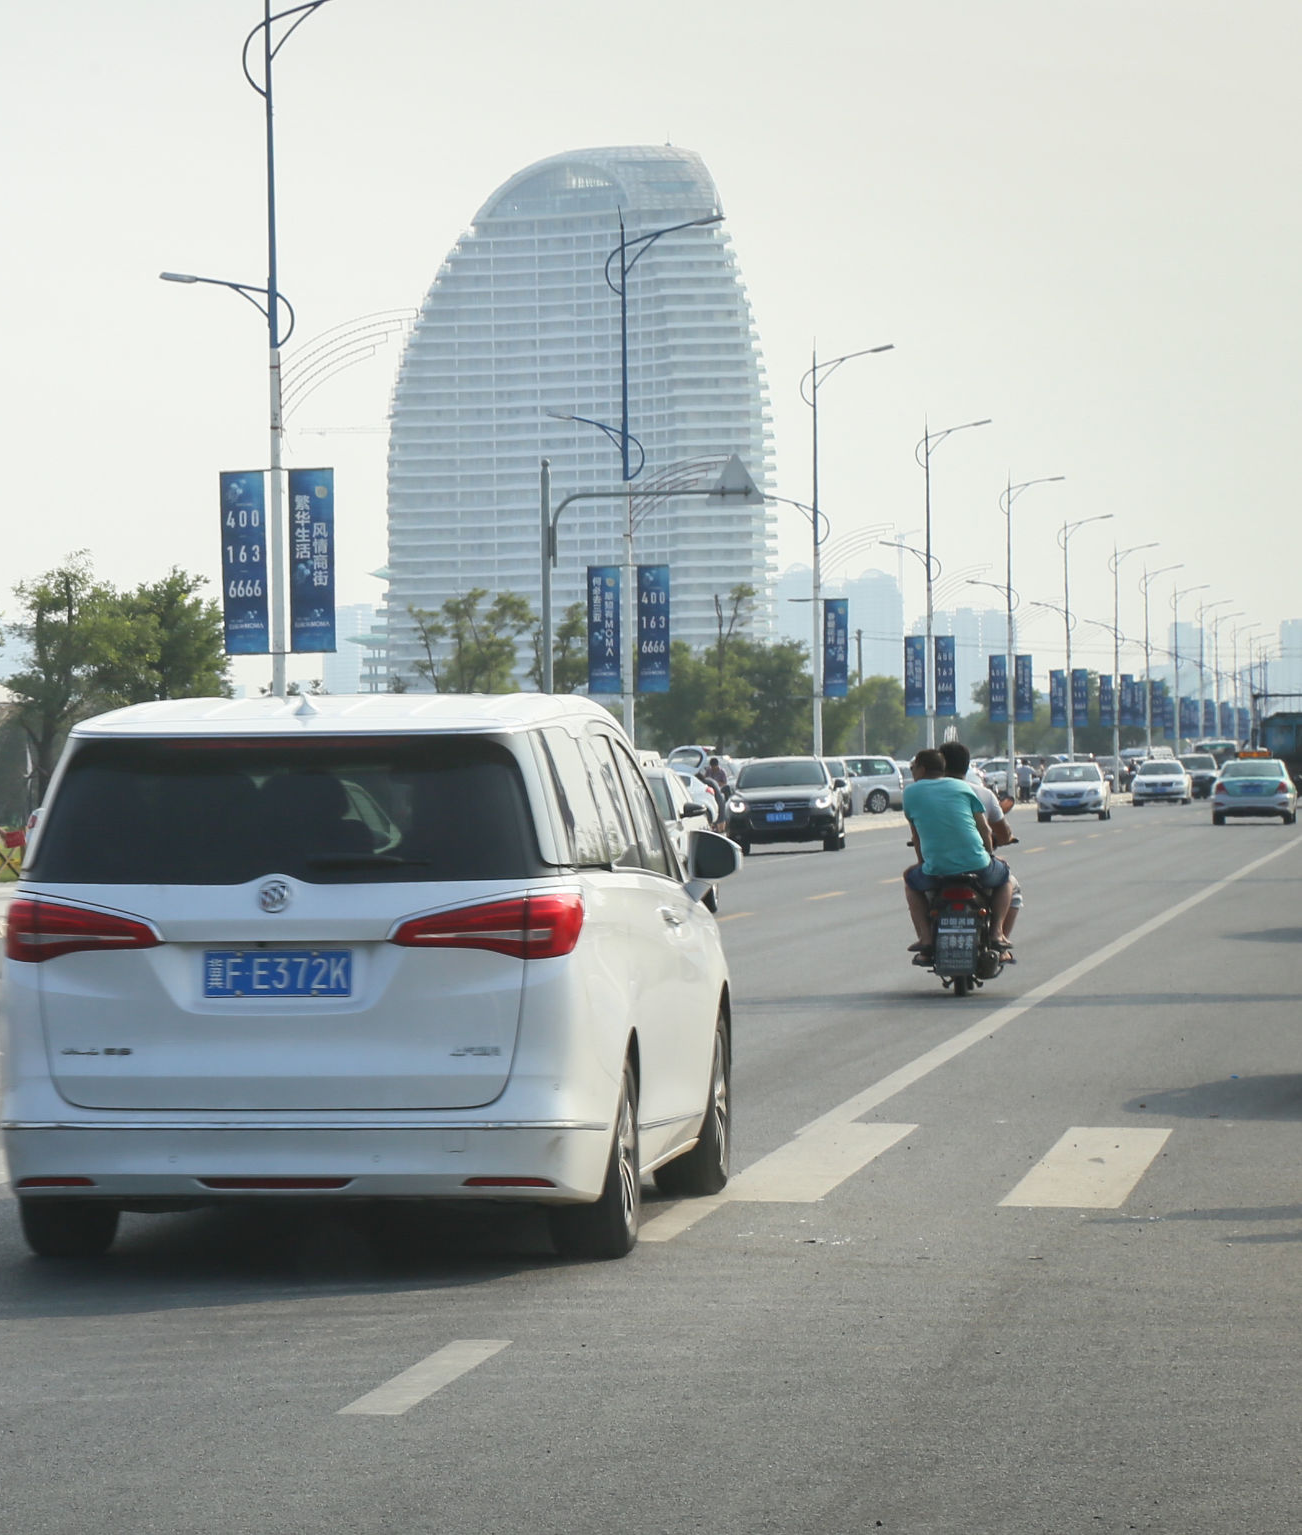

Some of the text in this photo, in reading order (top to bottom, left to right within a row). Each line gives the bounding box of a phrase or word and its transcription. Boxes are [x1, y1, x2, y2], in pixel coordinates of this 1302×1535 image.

[226, 509, 260, 529] 400
[294, 494, 311, 560] 繁华生活
[227, 545, 260, 564] 163
[312, 522, 328, 587] 风情商街
[229, 579, 262, 598] 6666
[641, 591, 666, 605] 400
[642, 615, 666, 629] 163
[642, 640, 665, 654] 6666
